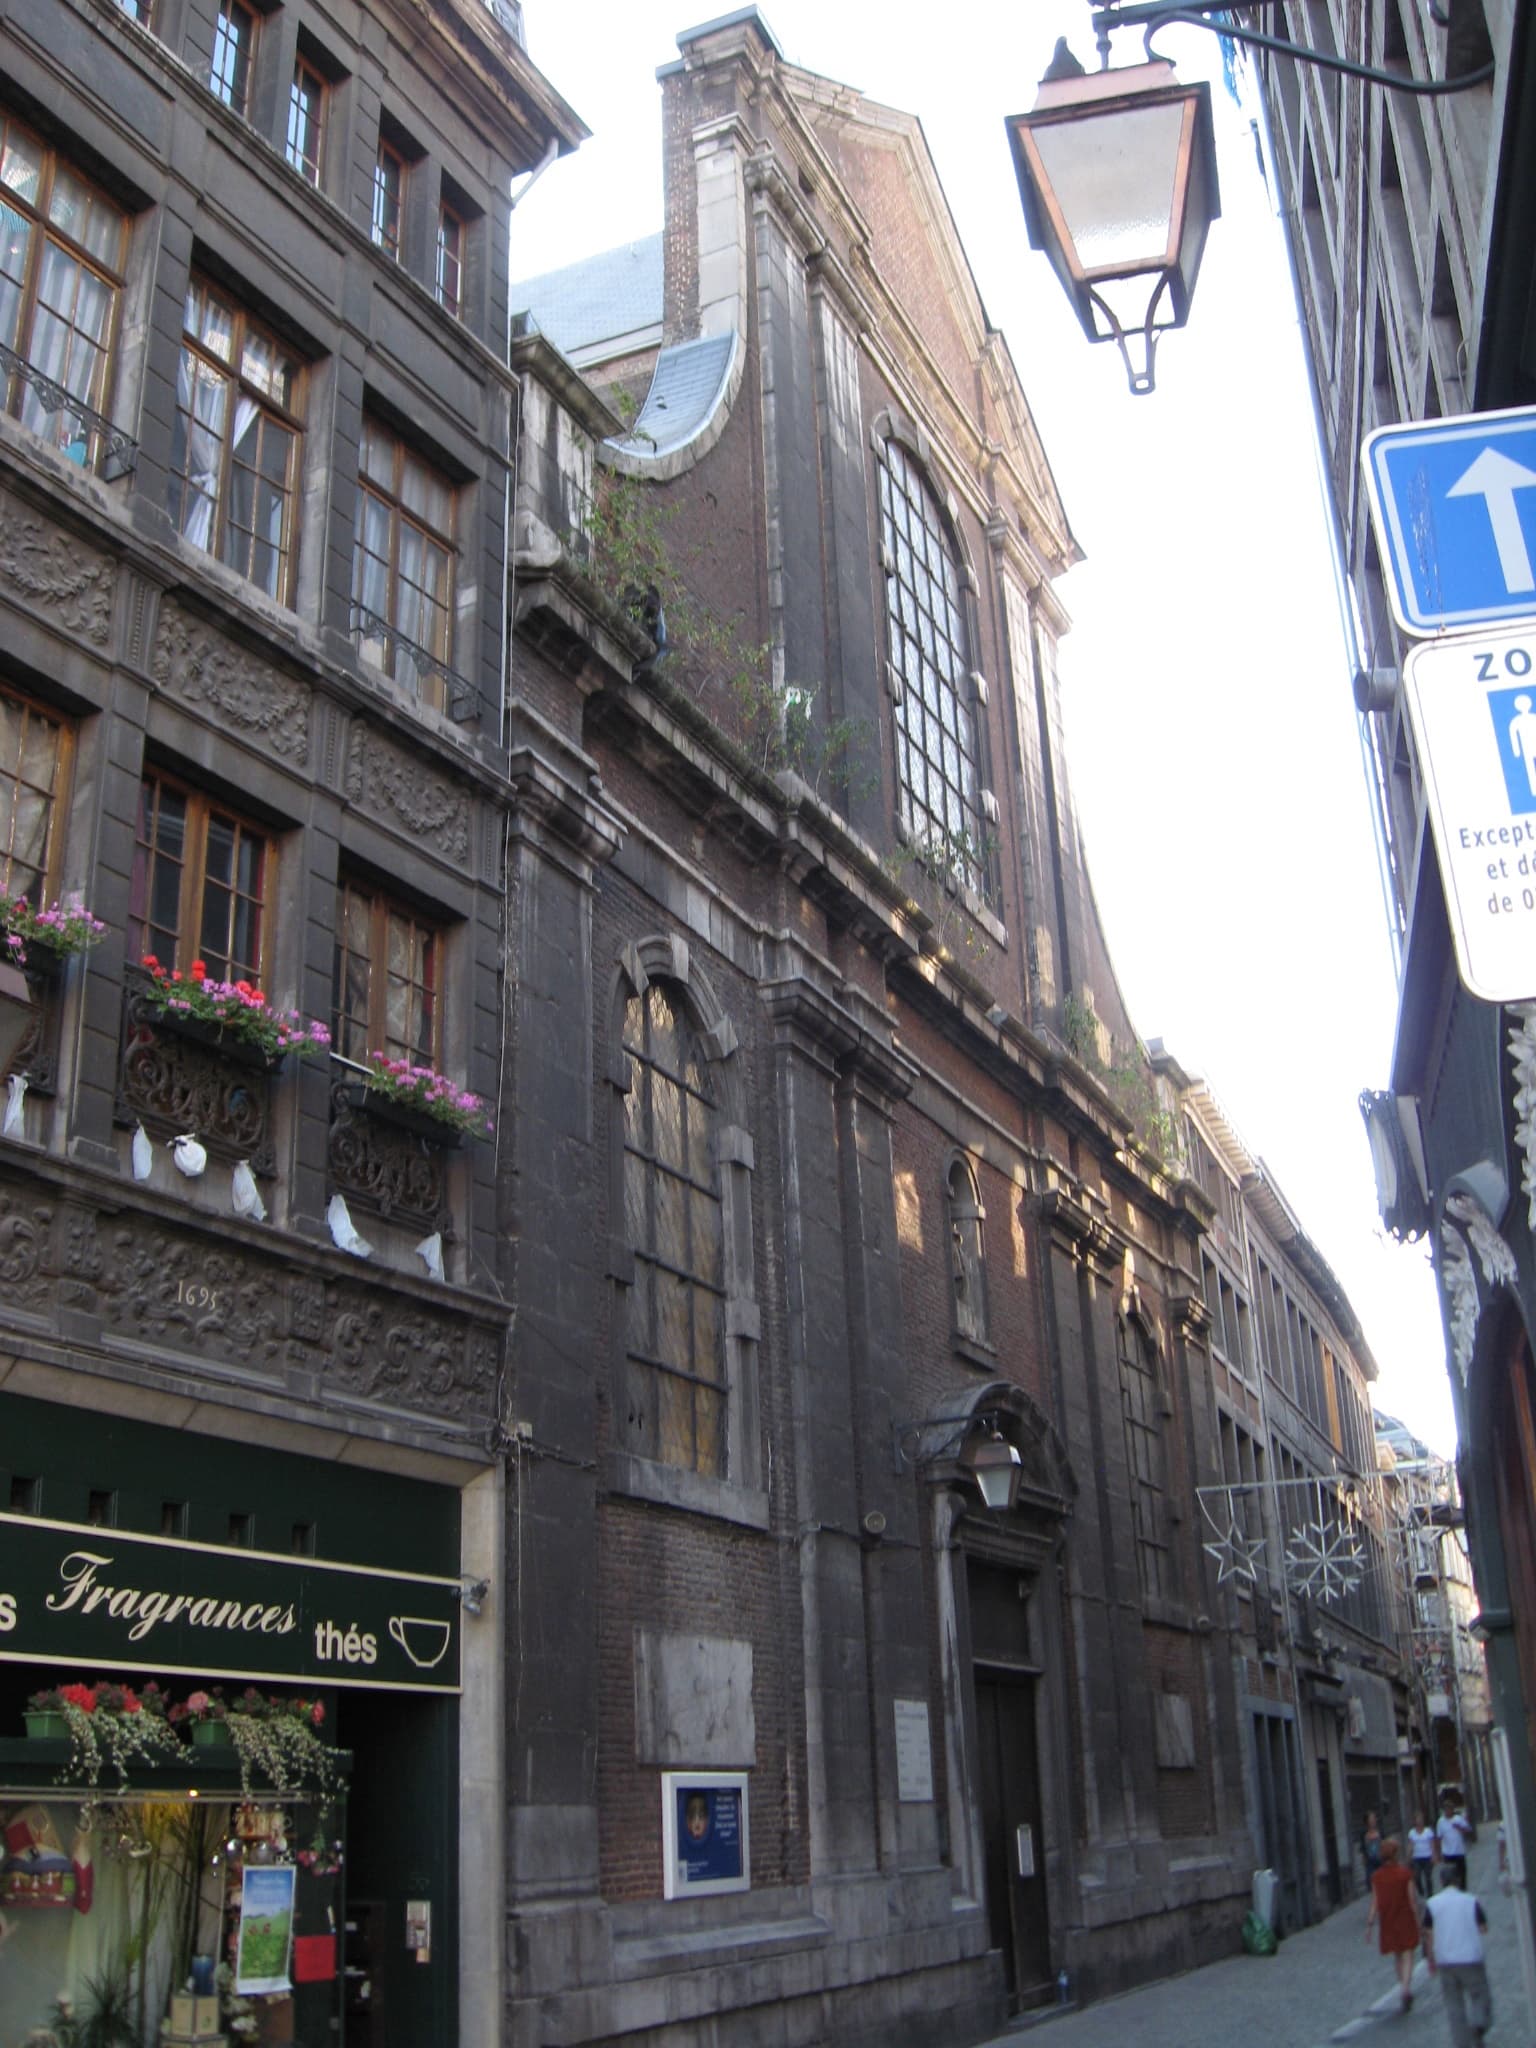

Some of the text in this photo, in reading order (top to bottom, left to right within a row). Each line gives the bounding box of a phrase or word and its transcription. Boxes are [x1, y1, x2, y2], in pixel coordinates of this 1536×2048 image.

[1473, 648, 1532, 682] ZO
[1459, 820, 1536, 849] Except
[1487, 857, 1509, 880] et
[1488, 887, 1536, 915] de 0
[46, 1551, 297, 1641] Fragrances
[315, 1620, 377, 1664] thés
